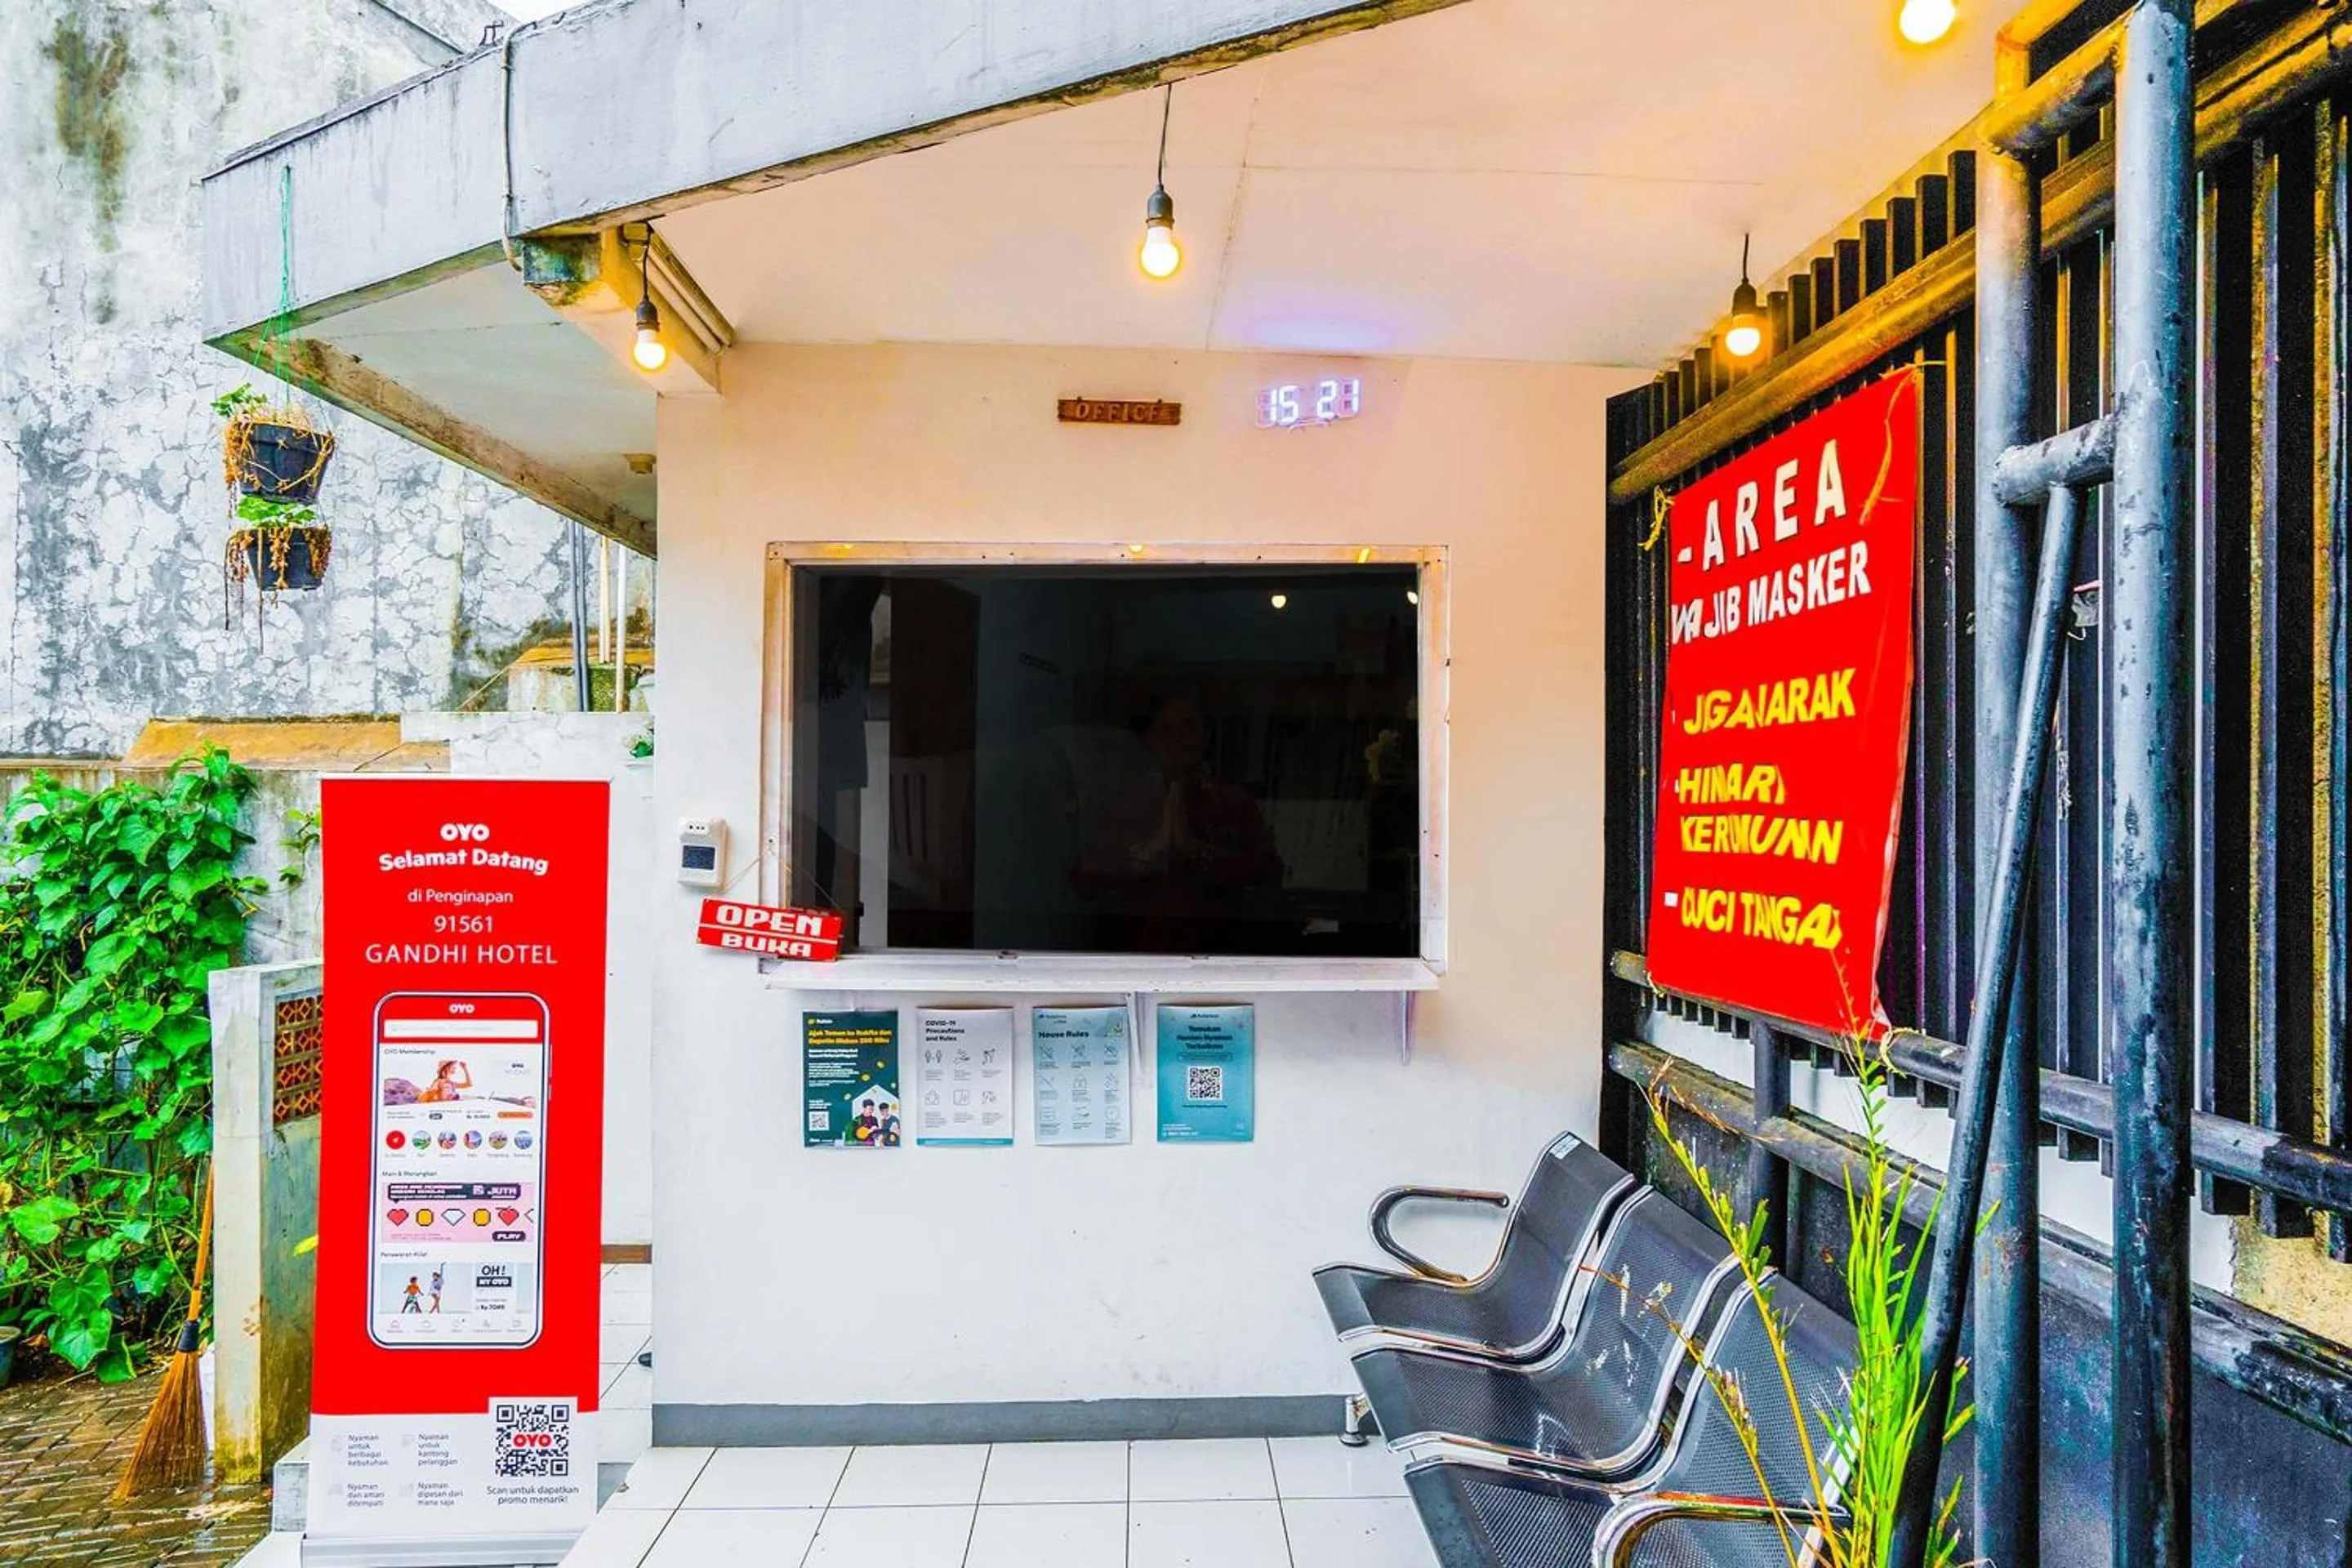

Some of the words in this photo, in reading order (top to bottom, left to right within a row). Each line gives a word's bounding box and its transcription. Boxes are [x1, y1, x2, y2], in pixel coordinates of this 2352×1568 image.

[1316, 378, 1360, 418] 21
[1076, 403, 1162, 423] OFFICE
[1703, 439, 1847, 572] AREA
[1748, 540, 1872, 627] MASKER
[440, 823, 490, 842] OYO
[378, 849, 467, 871] Selamat
[471, 848, 550, 876] Datang
[408, 889, 422, 903] di
[425, 889, 514, 906] Penginapan
[434, 915, 493, 933] 91561
[715, 904, 823, 938] OPEN
[720, 932, 813, 958] BUKA
[365, 943, 468, 964] GANDHI
[478, 944, 559, 964] HOTEL
[448, 1003, 475, 1014] OYO
[1038, 1031, 1065, 1039] House
[1066, 1030, 1090, 1038] Rules
[399, 1048, 436, 1056] Membership
[481, 1264, 506, 1276] OH!
[418, 1433, 450, 1441] Nyaman
[513, 1433, 552, 1448] OYO
[418, 1450, 450, 1459] kantong
[418, 1459, 458, 1468] pelanggan
[347, 1483, 379, 1491] Nyaman
[417, 1490, 447, 1499] dipesan
[487, 1486, 509, 1494] Scan
[510, 1486, 537, 1494] untuk
[537, 1485, 580, 1495] dapatkan
[497, 1496, 528, 1505] promo
[530, 1495, 568, 1503] menarik!
